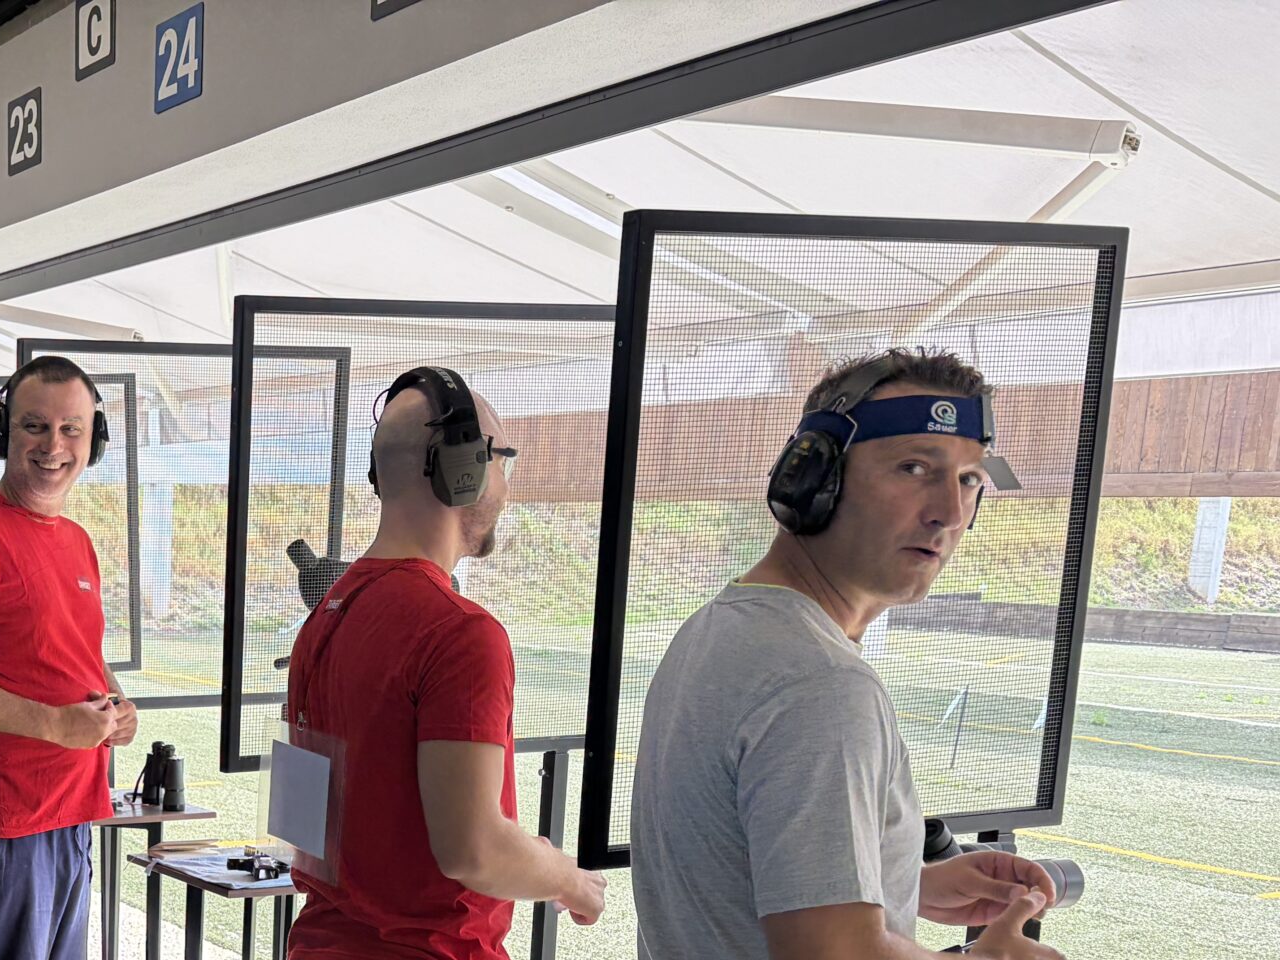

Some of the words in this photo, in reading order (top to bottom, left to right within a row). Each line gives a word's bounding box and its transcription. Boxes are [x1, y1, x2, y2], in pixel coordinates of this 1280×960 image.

[87, 5, 102, 57] C
[158, 16, 198, 101] 24
[10, 98, 38, 165] 23
[927, 421, 958, 432] Sauer
